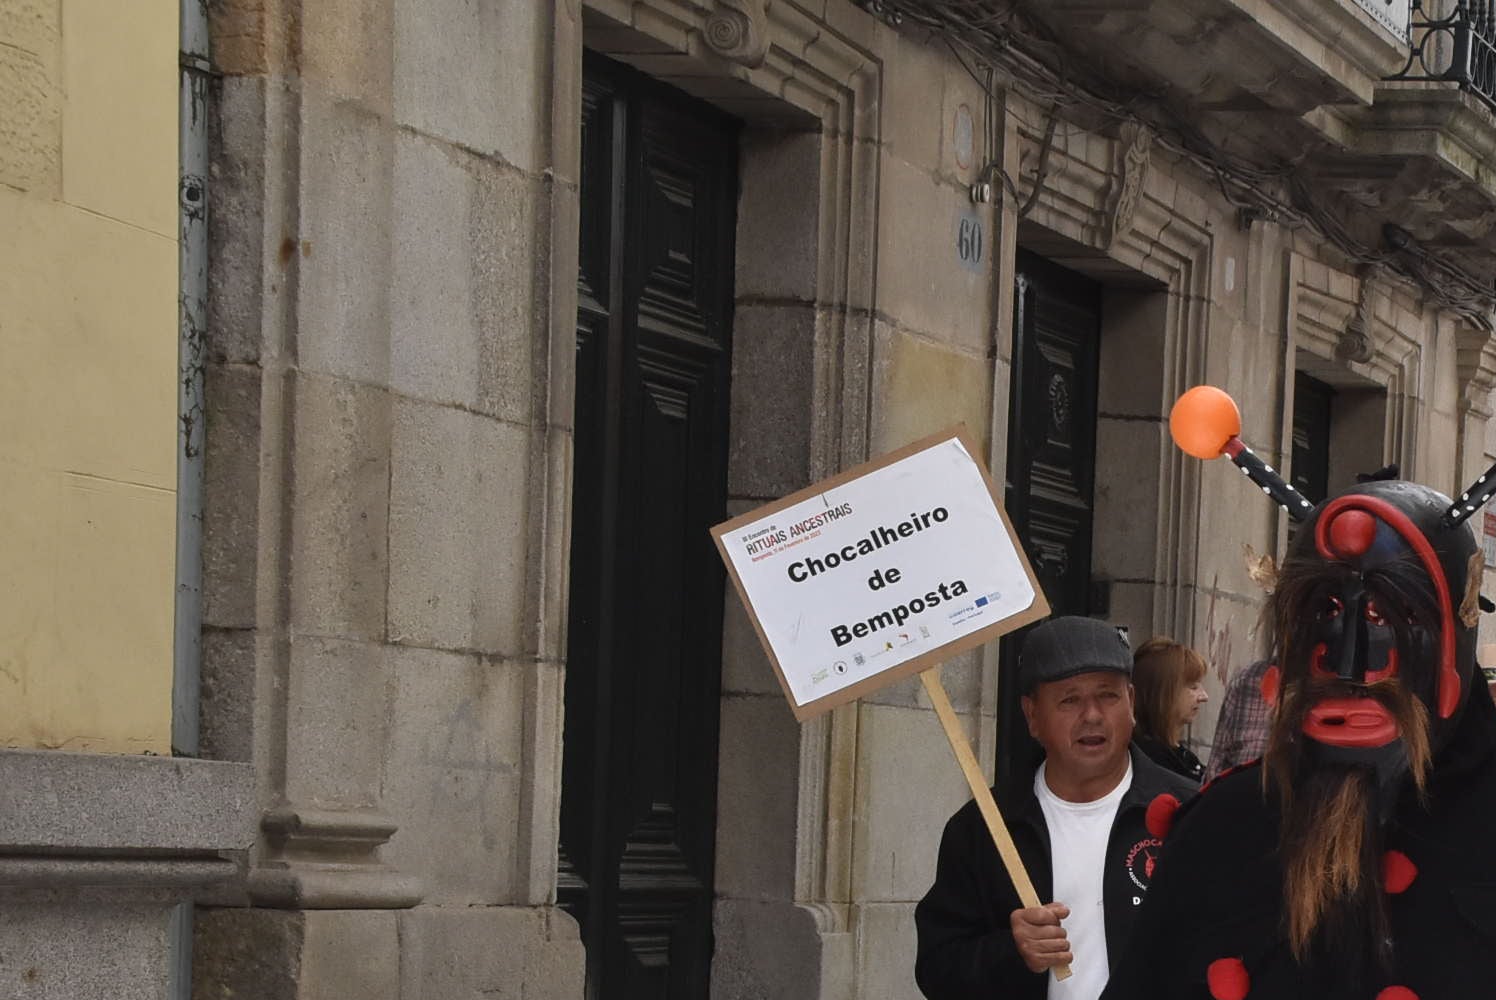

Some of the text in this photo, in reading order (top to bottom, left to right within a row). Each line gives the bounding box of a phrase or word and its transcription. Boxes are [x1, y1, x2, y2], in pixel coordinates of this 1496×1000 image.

[959, 219, 982, 264] 60
[745, 503, 853, 556] RITUAIS ANCESTRAIS
[787, 505, 949, 583] Chocalheiro
[867, 567, 902, 591] de
[830, 578, 968, 647] Bemposta
[1132, 896, 1143, 906] D
